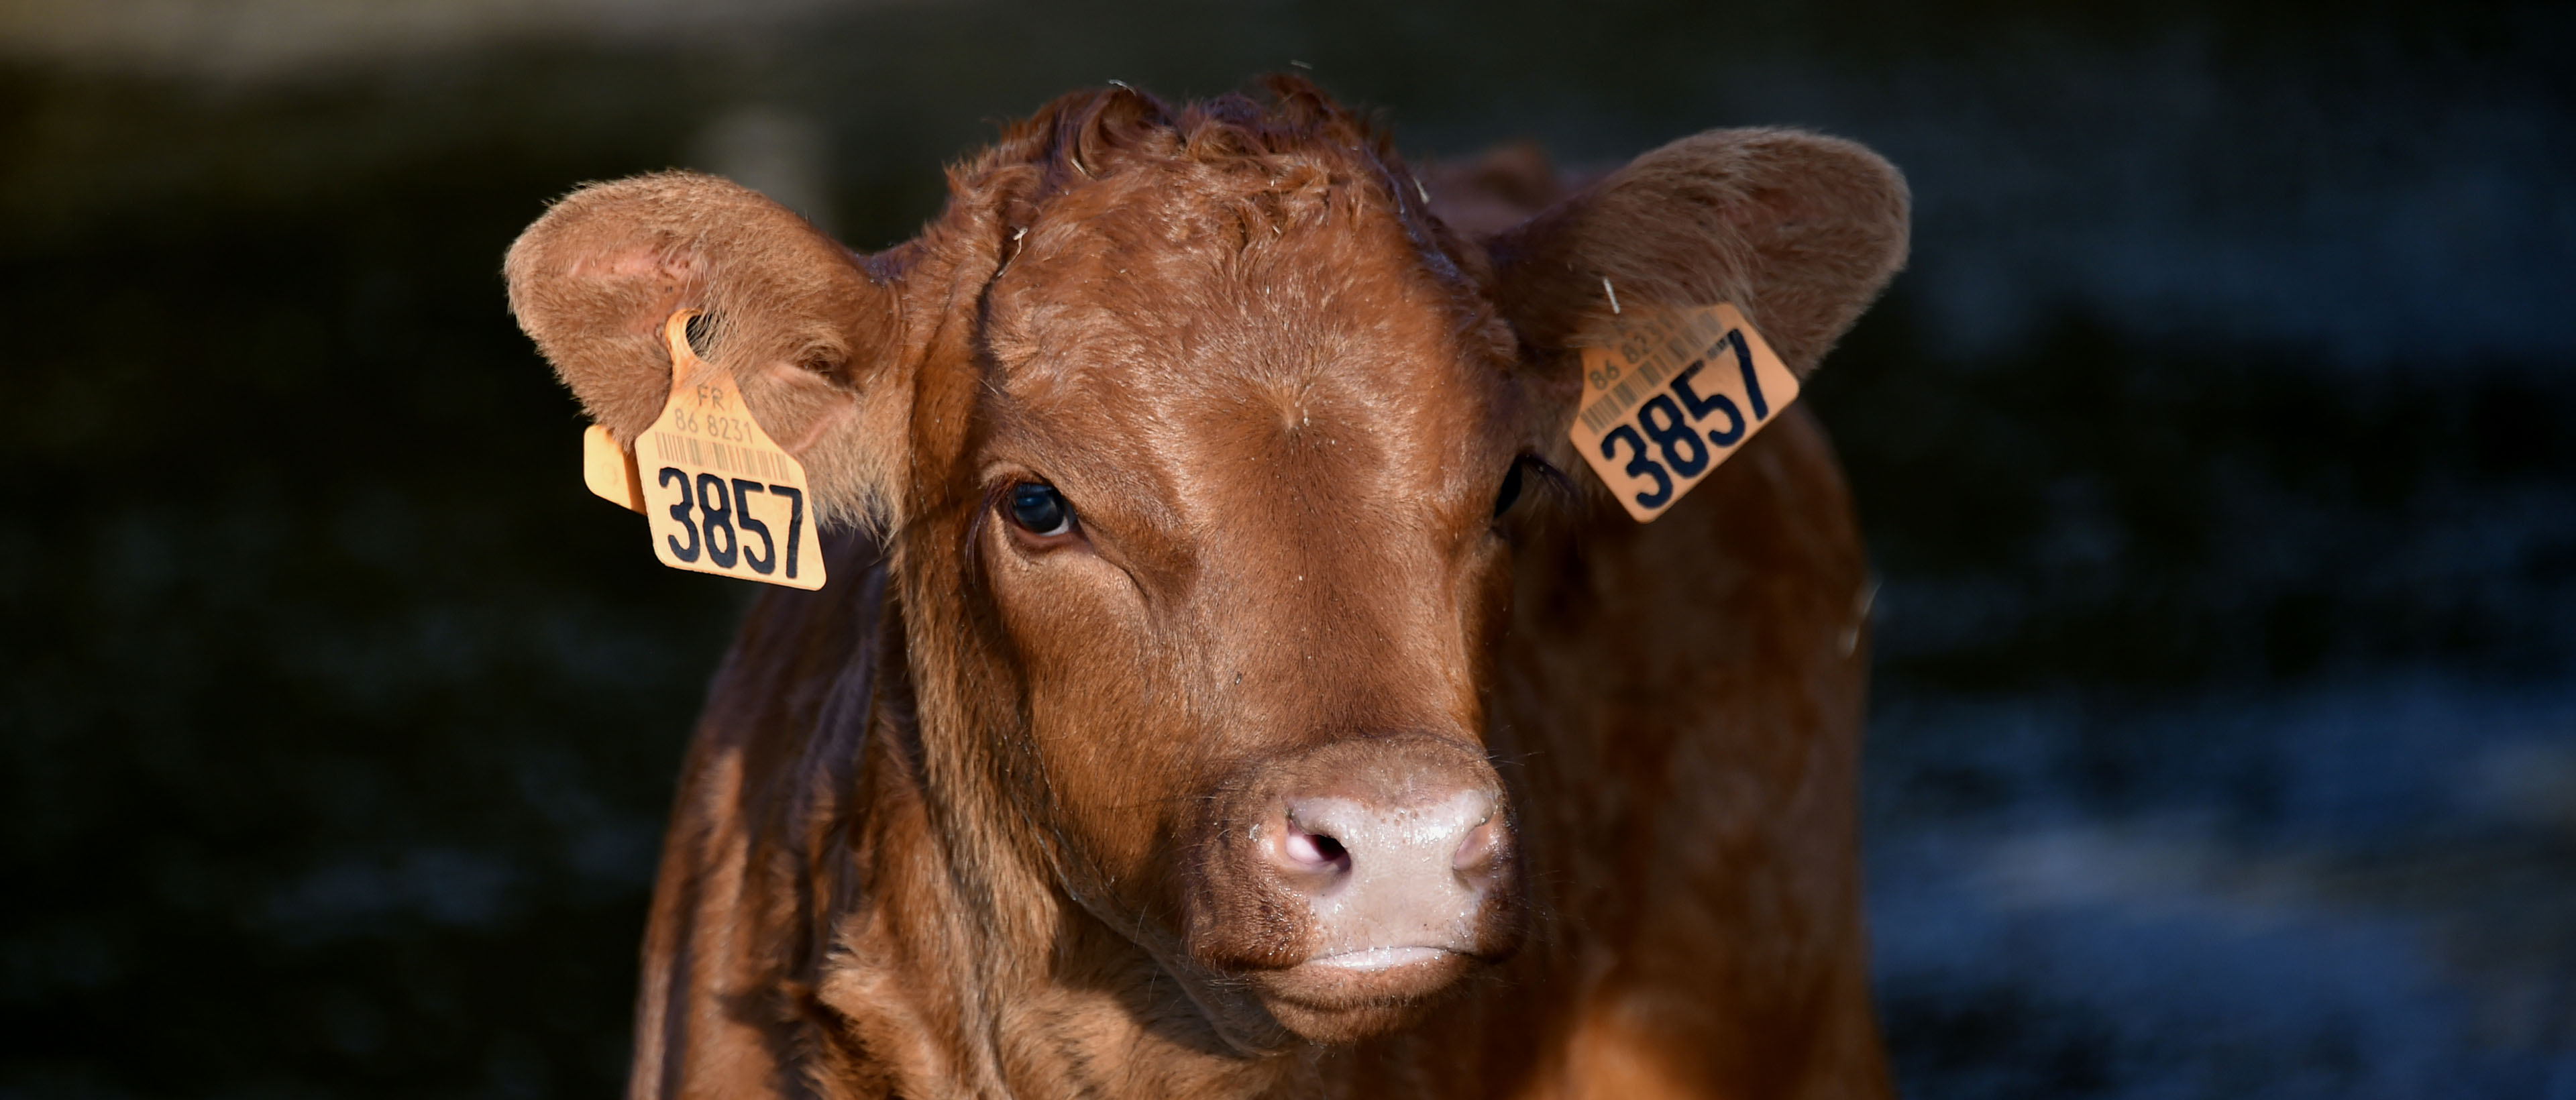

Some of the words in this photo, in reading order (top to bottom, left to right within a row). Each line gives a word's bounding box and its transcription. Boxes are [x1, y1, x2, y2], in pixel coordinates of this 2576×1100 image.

[1589, 359, 1620, 390] 86
[697, 384, 724, 410] FR
[675, 408, 698, 433] 86
[708, 415, 754, 443] 8231
[1601, 328, 1769, 509] 3857
[659, 467, 803, 579] 3857
